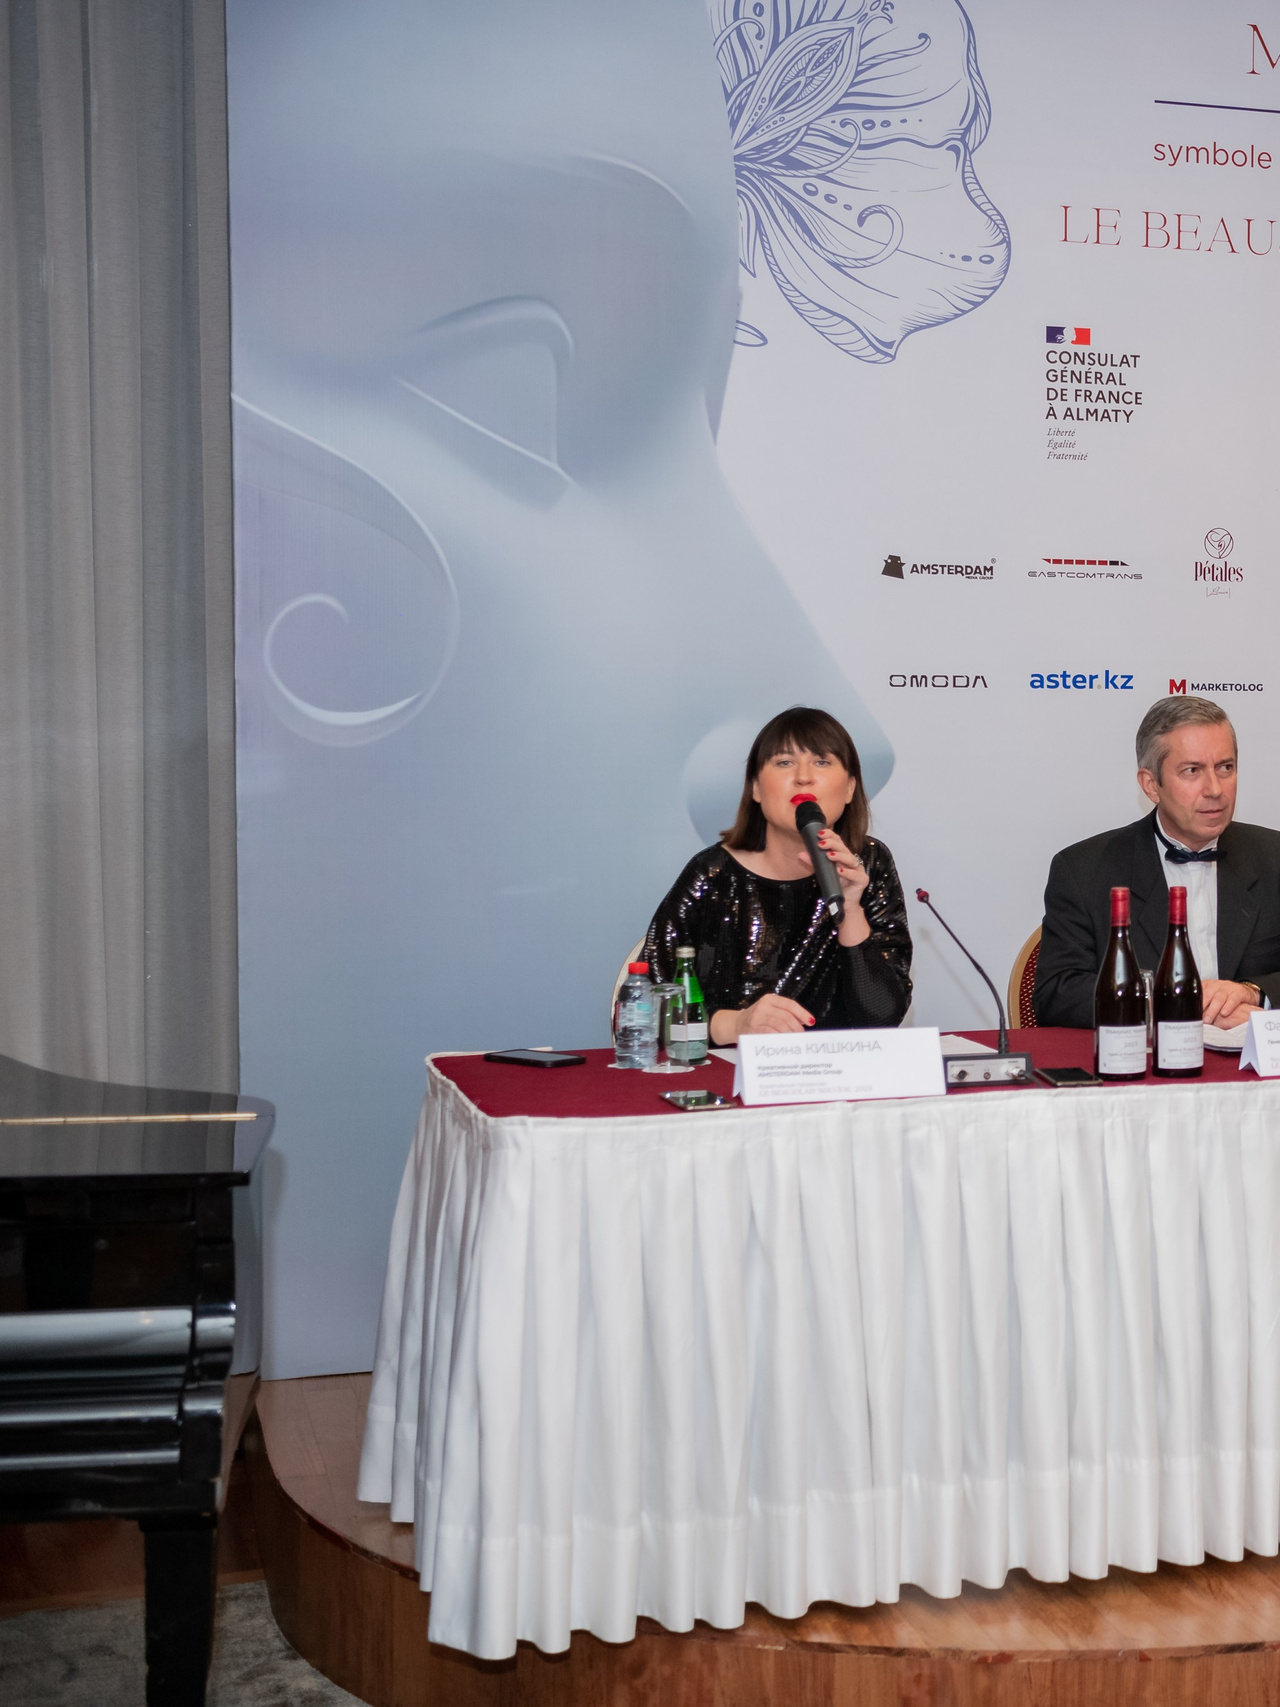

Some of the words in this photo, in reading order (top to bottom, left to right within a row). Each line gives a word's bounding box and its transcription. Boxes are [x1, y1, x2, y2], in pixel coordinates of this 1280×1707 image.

[1152, 140, 1273, 171] symbole
[1060, 204, 1123, 248] LE
[1045, 350, 1141, 369] CONSULAT
[1045, 366, 1127, 386] GÉNÉRAL
[1046, 387, 1068, 402] DE
[1074, 388, 1143, 405] FRANCE
[1045, 402, 1058, 420] À
[1062, 406, 1135, 423] ALMATY
[1046, 428, 1076, 437] Liberté
[1046, 438, 1077, 450] Égalité
[1046, 451, 1089, 461] Fraternité
[910, 563, 994, 577] AMSTERDAM
[1027, 571, 1143, 580] EASTCOMTRANS
[1194, 560, 1244, 582] Pétales
[889, 674, 988, 688] OMODA
[1029, 669, 1134, 690] aster.kz
[1191, 683, 1264, 692] MARKETOLOG
[754, 1044, 802, 1057] Ирина
[806, 1040, 882, 1054] КИШКИНА
